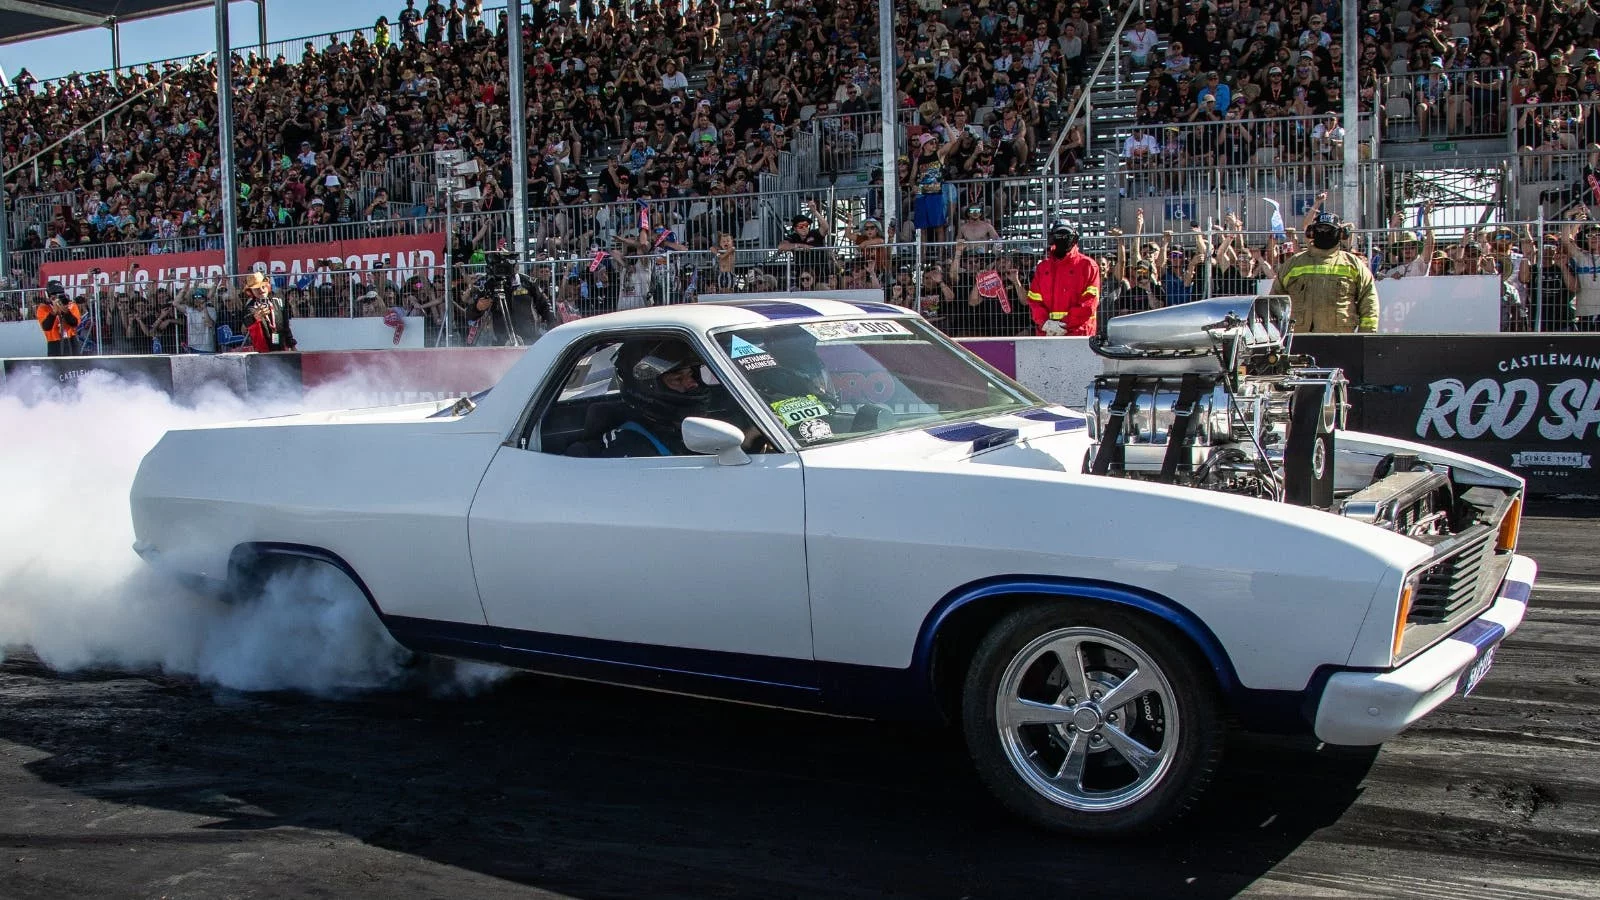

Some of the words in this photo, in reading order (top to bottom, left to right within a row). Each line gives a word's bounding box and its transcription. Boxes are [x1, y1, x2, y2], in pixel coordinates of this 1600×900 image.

[859, 322, 898, 333] 0107
[789, 406, 821, 422] 0107
[1416, 378, 1539, 439] ROD
